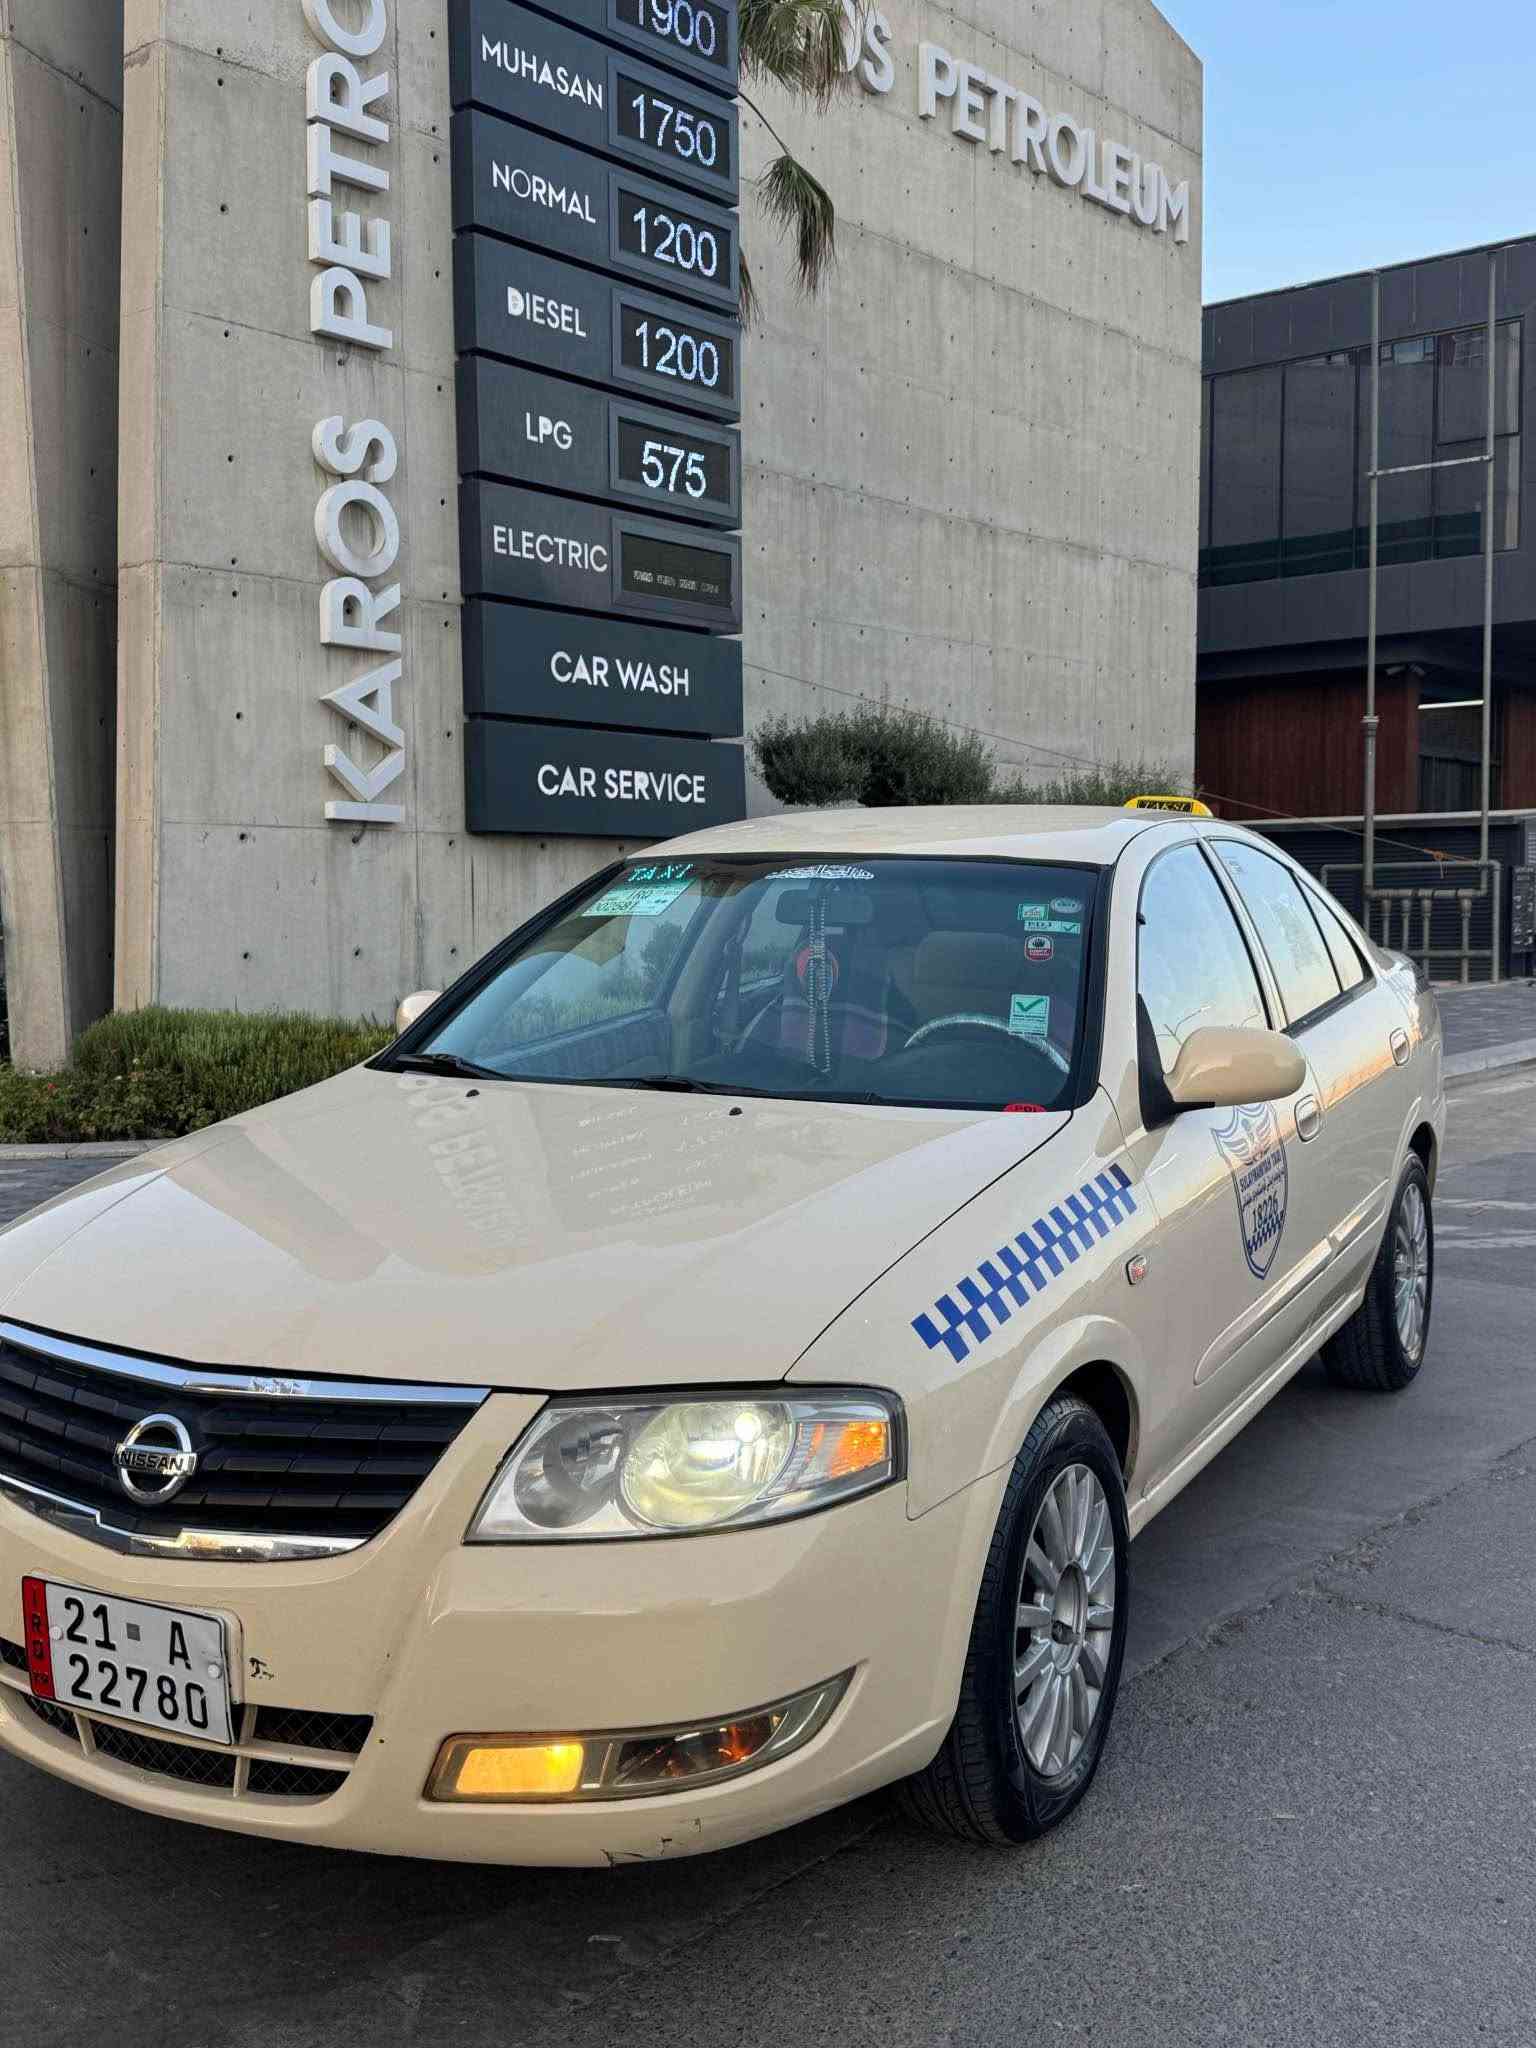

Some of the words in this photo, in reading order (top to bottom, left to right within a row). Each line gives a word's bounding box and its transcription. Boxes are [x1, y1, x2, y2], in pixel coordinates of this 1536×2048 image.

[639, 0, 716, 56] 1900
[481, 33, 603, 109] MUHASAN
[631, 93, 717, 166] 1750
[918, 41, 1190, 245] PETROLEUM
[491, 160, 596, 224] NORMAL
[632, 207, 718, 277] 1200
[507, 286, 587, 337] DIESEL
[635, 321, 719, 387] 1200
[525, 411, 573, 450] LPG
[641, 440, 707, 498] 575
[493, 525, 608, 573] ELECTRIC
[311, 415, 405, 822] KAROS
[550, 651, 608, 688] CAR
[616, 657, 689, 696] WASH
[537, 763, 596, 798] CAR
[604, 769, 706, 804] SERVICE
[119, 1451, 184, 1472] NISSAN
[64, 1597, 116, 1651] 21
[168, 1620, 192, 1670] A
[69, 1654, 209, 1730] 22780
